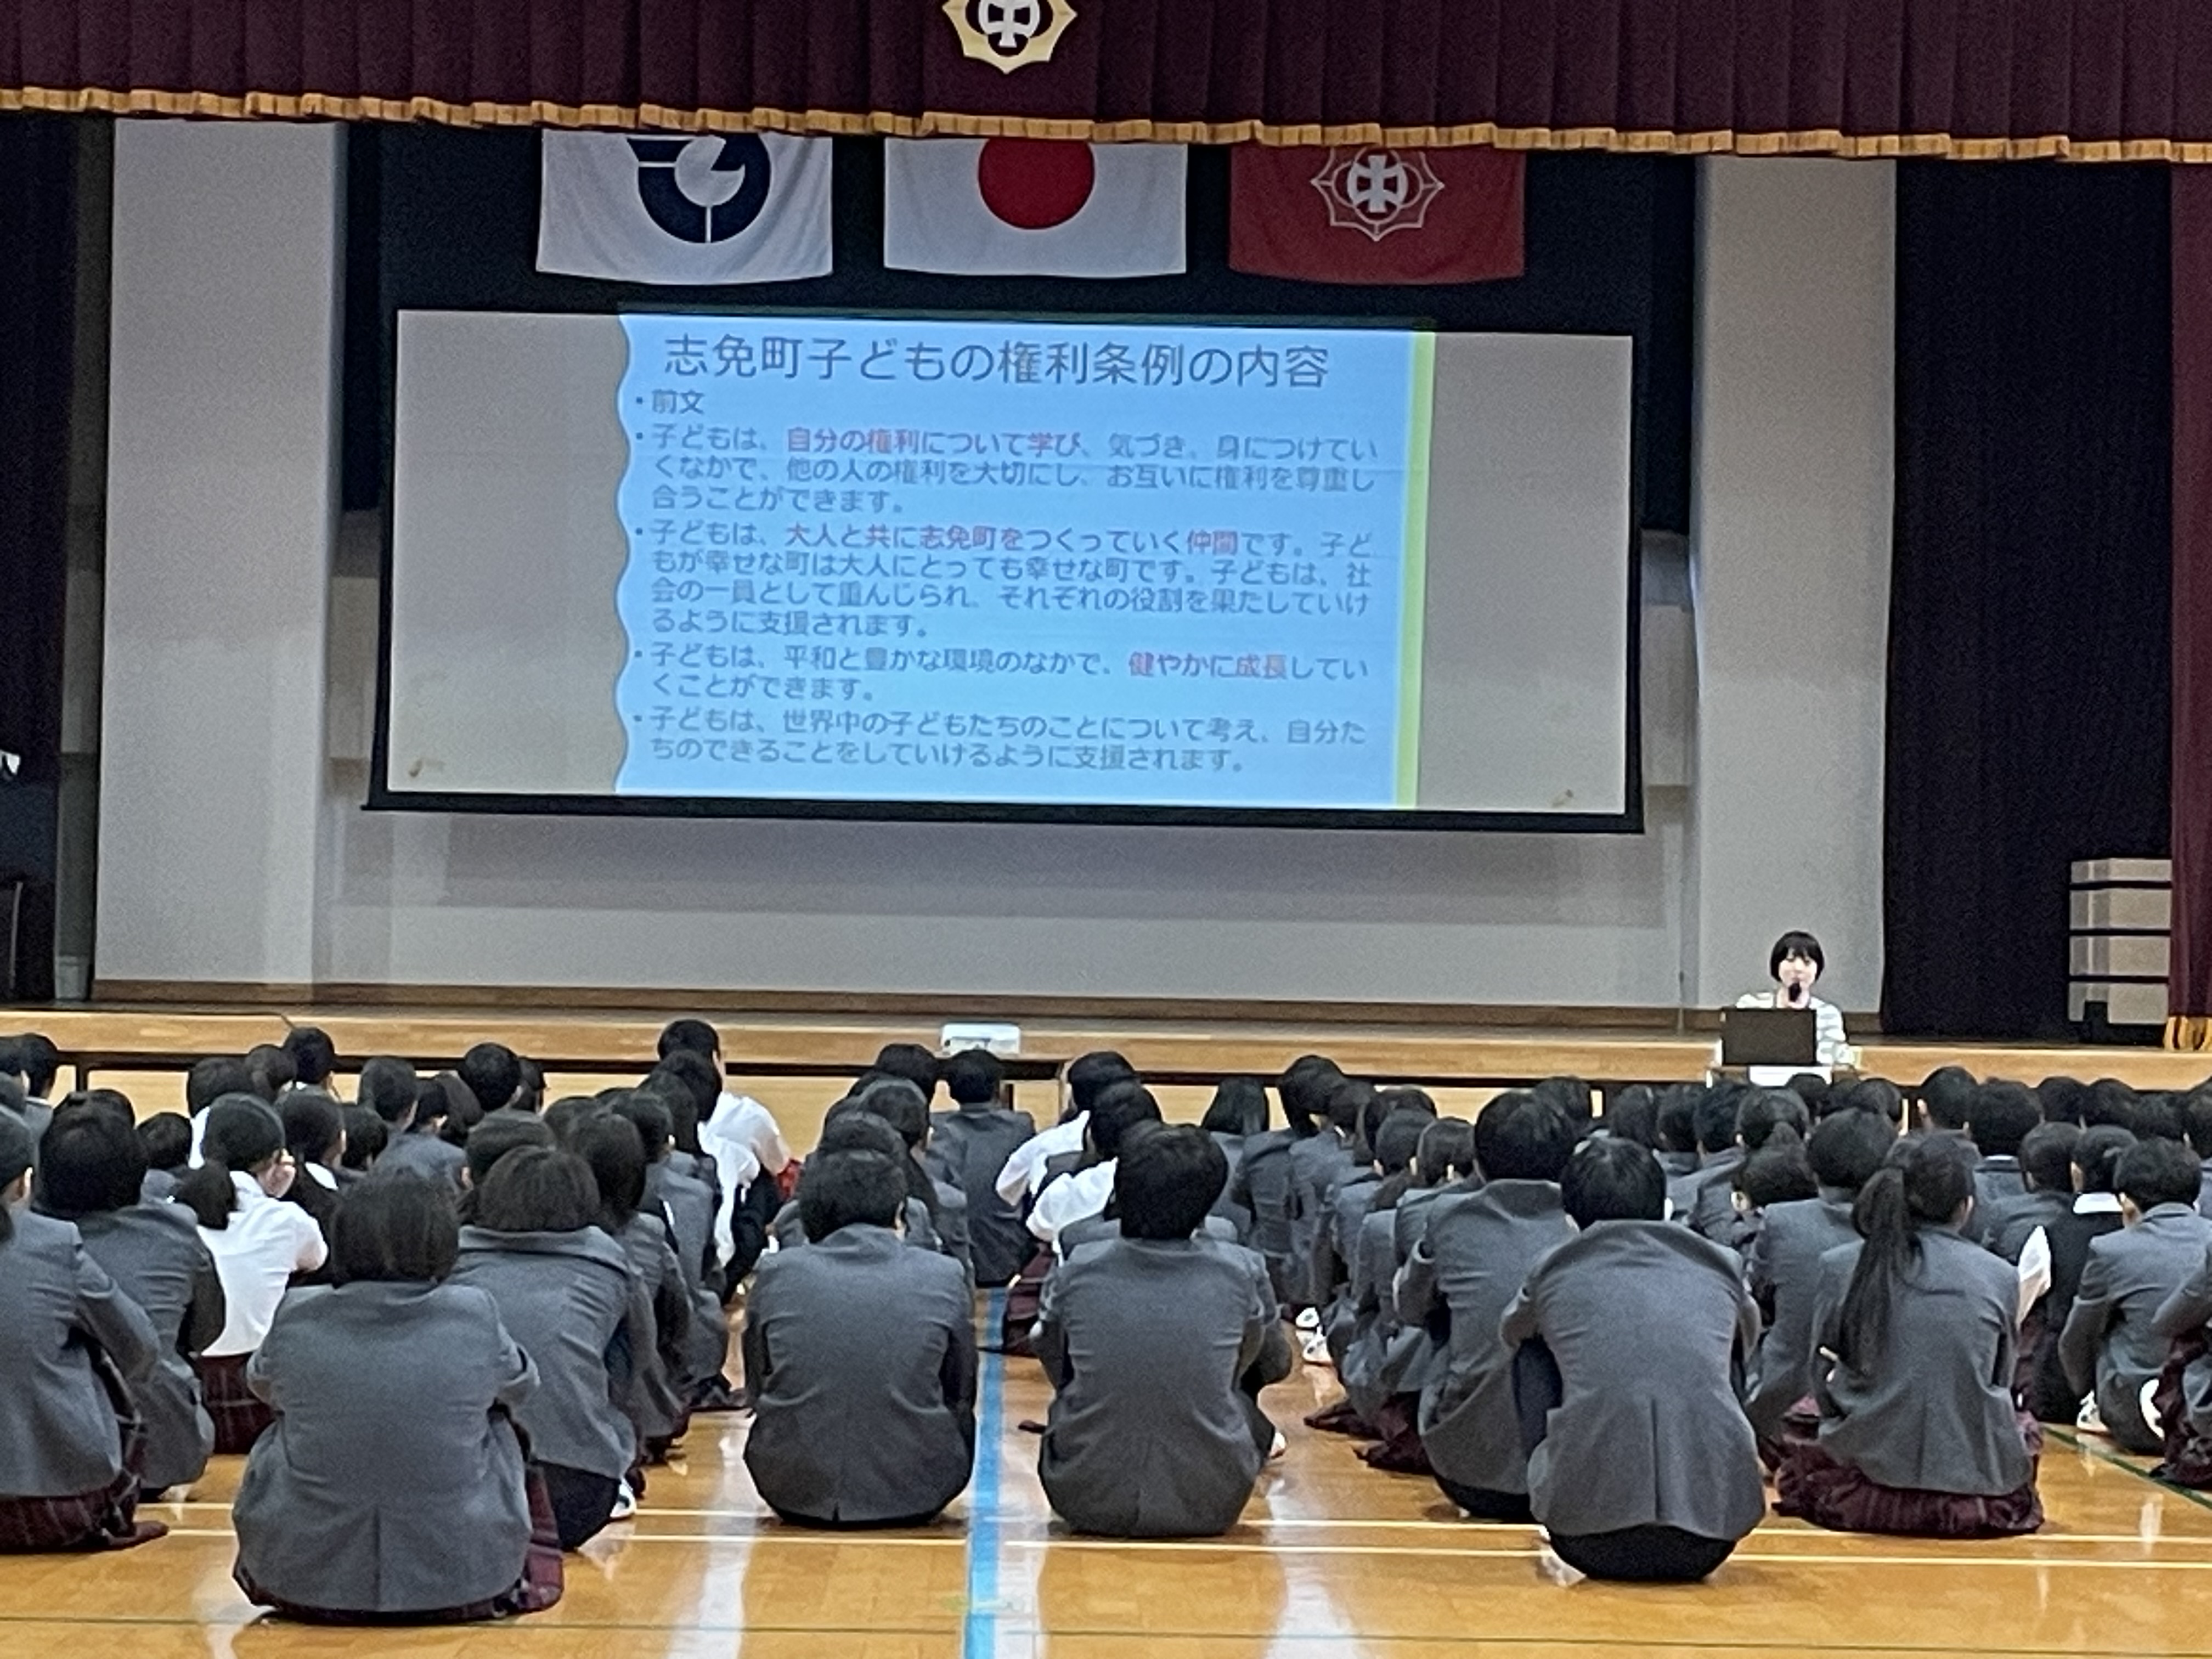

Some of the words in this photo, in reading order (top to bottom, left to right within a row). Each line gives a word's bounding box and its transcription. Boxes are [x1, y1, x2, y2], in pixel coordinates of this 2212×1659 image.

[664, 333, 1329, 388] 志免町子どもの権利条例の内容
[651, 389, 705, 415] 前文
[652, 486, 904, 514] 合うことができます。
[652, 609, 928, 638] るように支援されます。
[652, 673, 873, 702] くことができます。
